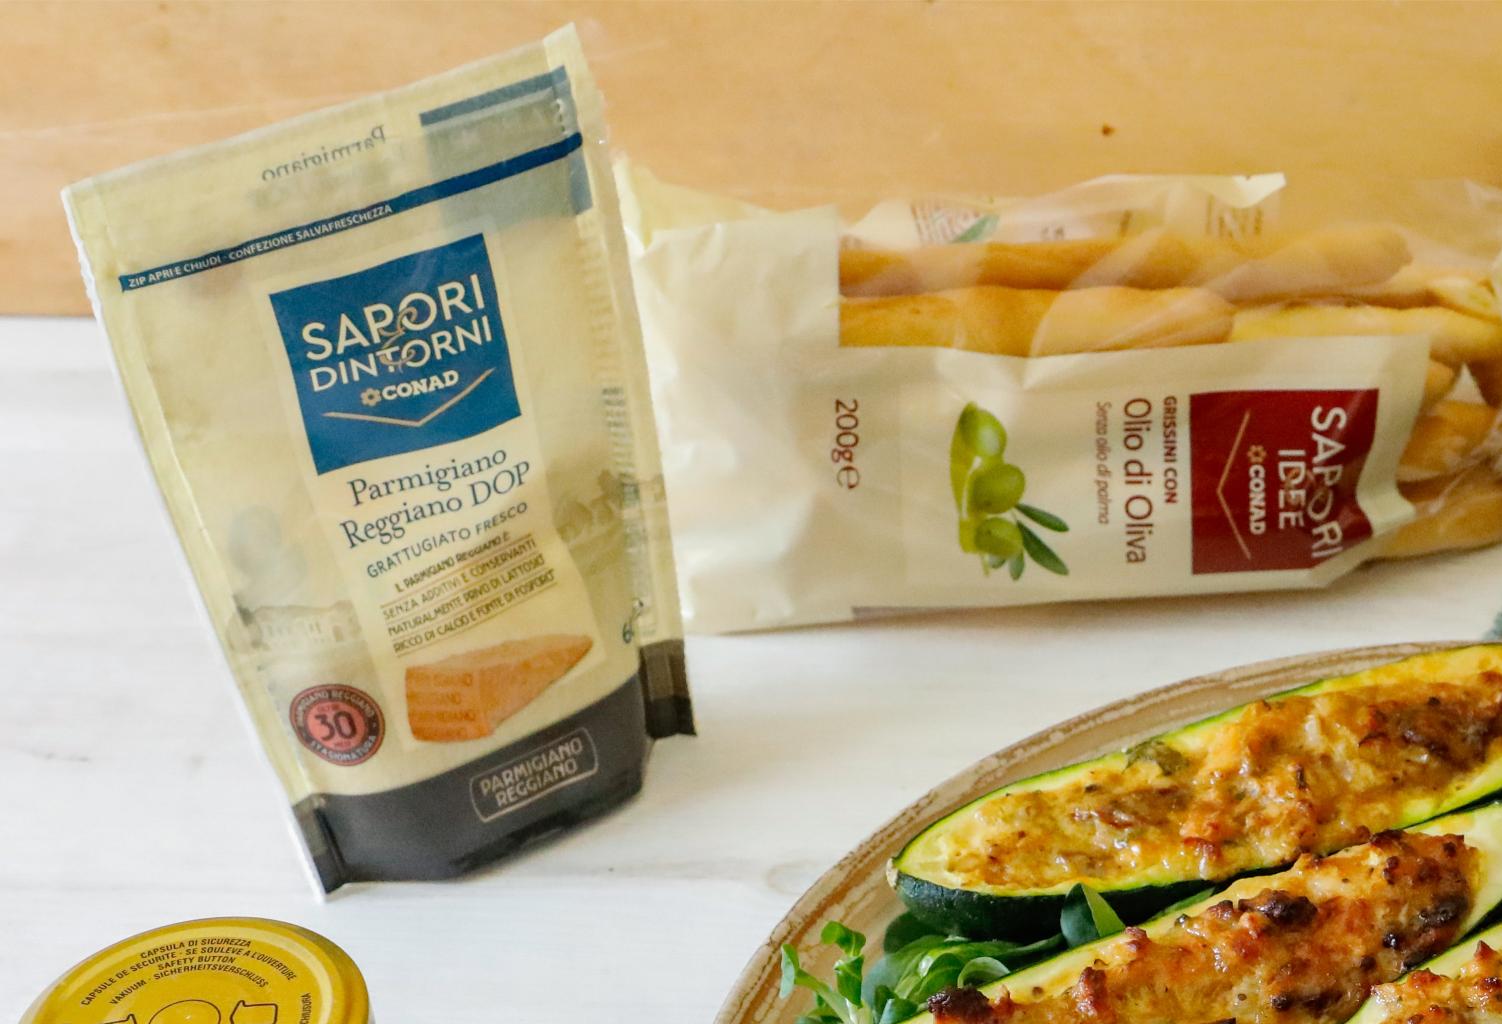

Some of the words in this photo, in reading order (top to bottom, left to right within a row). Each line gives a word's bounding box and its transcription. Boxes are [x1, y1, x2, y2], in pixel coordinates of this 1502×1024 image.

[128, 276, 146, 289] ZIP
[148, 268, 174, 284] APRI
[175, 266, 181, 276] E
[184, 255, 221, 272] CHIUDI
[229, 234, 294, 260] CONFEZIONE
[296, 204, 393, 241] SALVAFRESCHEZZA
[302, 273, 486, 361] SAPORI
[310, 315, 493, 392] DINTORNI
[382, 370, 459, 400] CONAD
[1124, 397, 1152, 451] Olio
[1163, 396, 1177, 463] GRISSINI
[347, 449, 507, 507] Parmigiano
[1124, 459, 1154, 485] di
[1163, 468, 1178, 504] CON
[1249, 464, 1266, 534] CONAD
[1311, 405, 1348, 558] SAPORI
[339, 497, 462, 549] Reggiano
[469, 461, 530, 507] DOP
[1125, 495, 1154, 564] Oliva
[367, 527, 471, 579] GRATTUGIATO
[475, 502, 528, 535] FRESCO
[382, 600, 418, 620] SENZA
[421, 578, 461, 602] ADDITIVI
[462, 573, 469, 583] E
[403, 557, 456, 589] PARMIGIANO
[315, 711, 357, 741] 30
[479, 737, 583, 797] PARMIGIANO
[495, 759, 578, 807] REGGIANO
[81, 977, 117, 1006] CAPSULE
[116, 969, 130, 979] DE
[185, 948, 198, 956] SE
[140, 941, 185, 959] CAPSULA
[188, 939, 198, 947] DI
[201, 938, 251, 947] SICUREZZA
[157, 956, 195, 971] SAFETY
[197, 955, 236, 964] BUTTON
[109, 979, 147, 1005] VAKUUM
[153, 963, 269, 988] SICHERHEITSVERSCHLUSS
